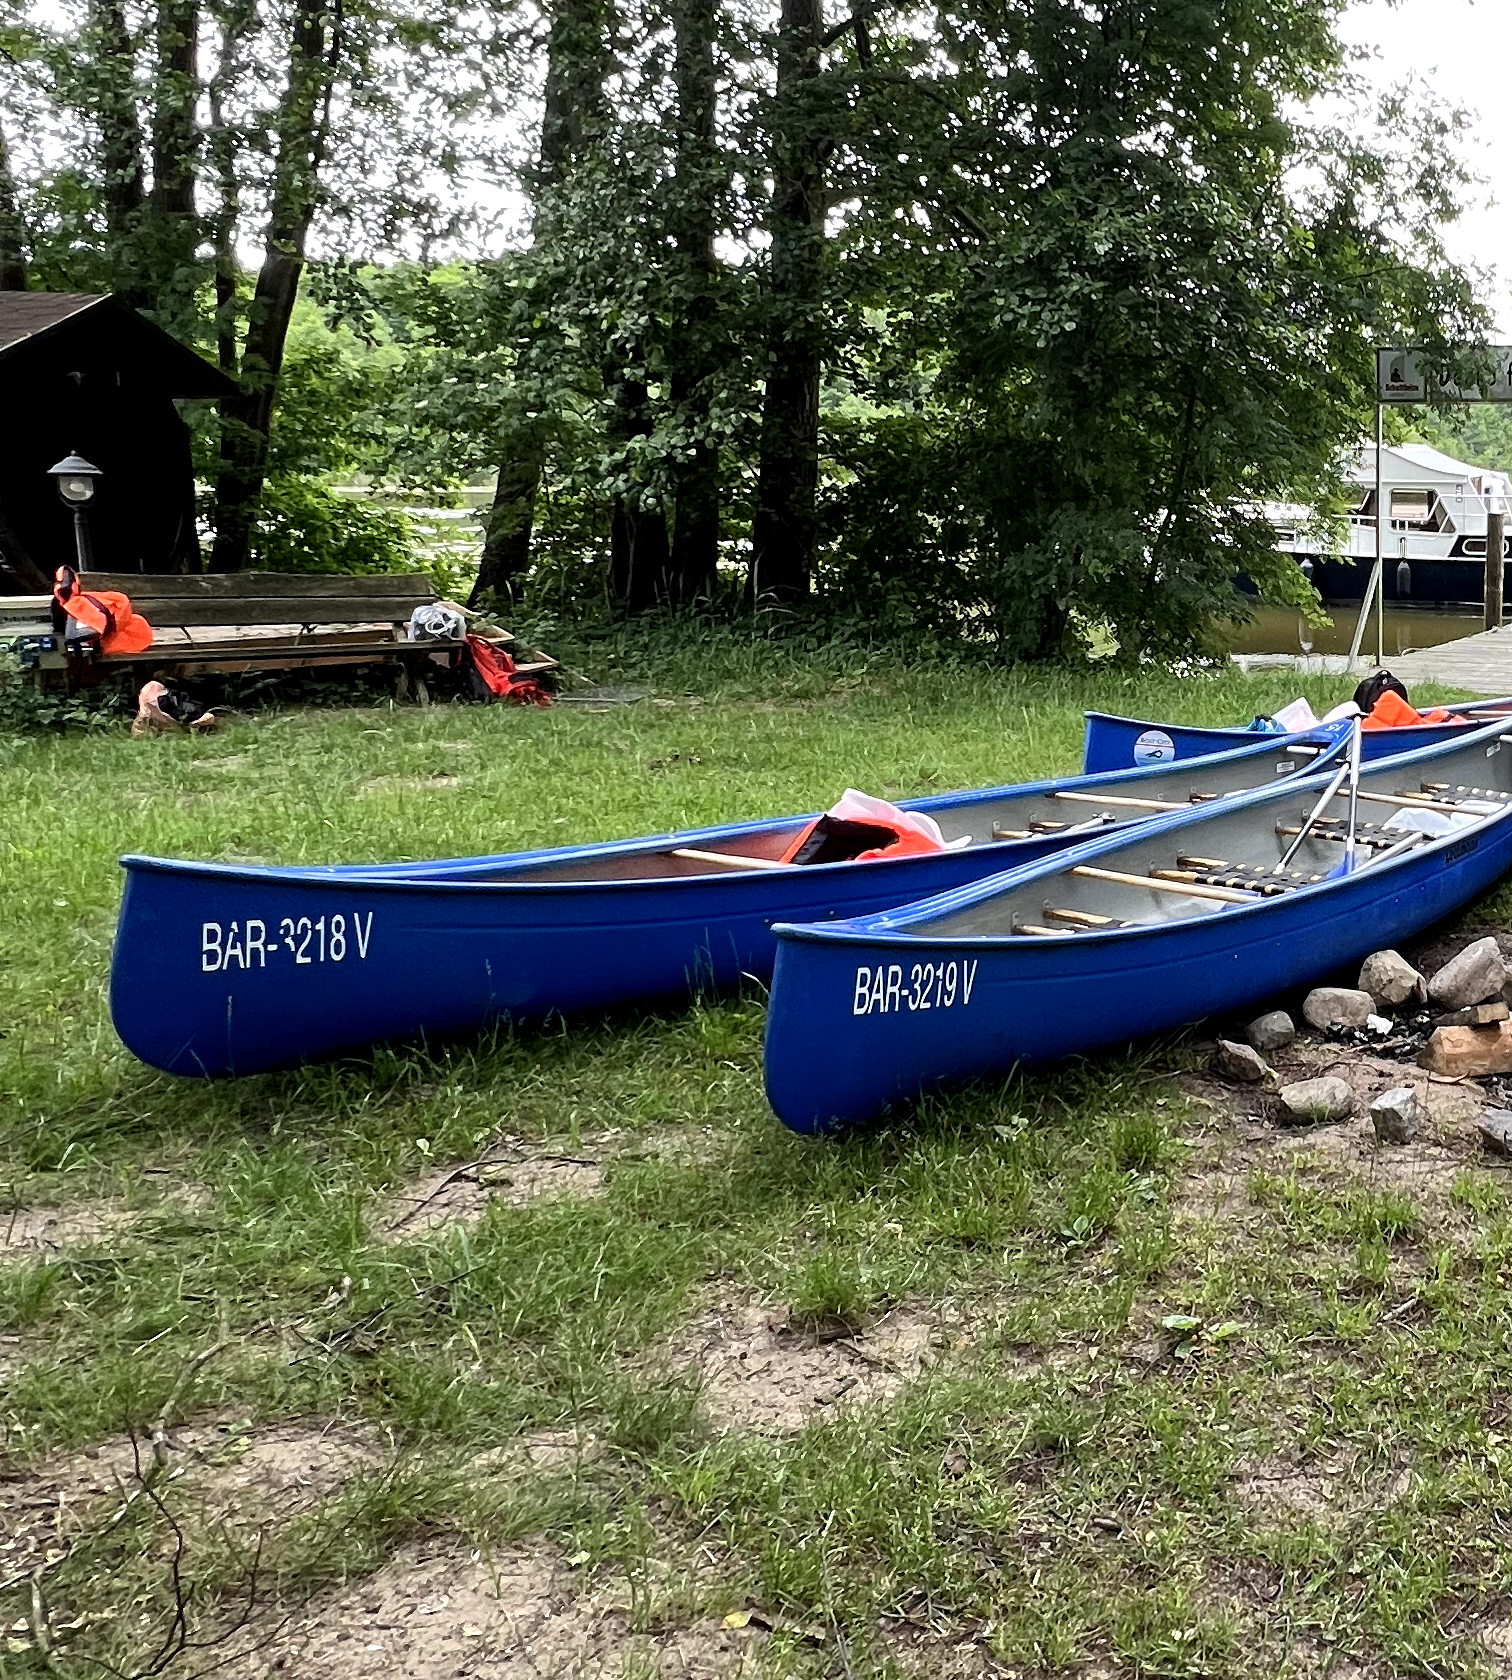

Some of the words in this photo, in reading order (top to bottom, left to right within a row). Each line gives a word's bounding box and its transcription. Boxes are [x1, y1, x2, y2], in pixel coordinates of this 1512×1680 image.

[202, 914, 346, 971] BAR-3218
[353, 911, 373, 959] V
[853, 961, 958, 1016] BAR-3219
[963, 959, 978, 1005] V
